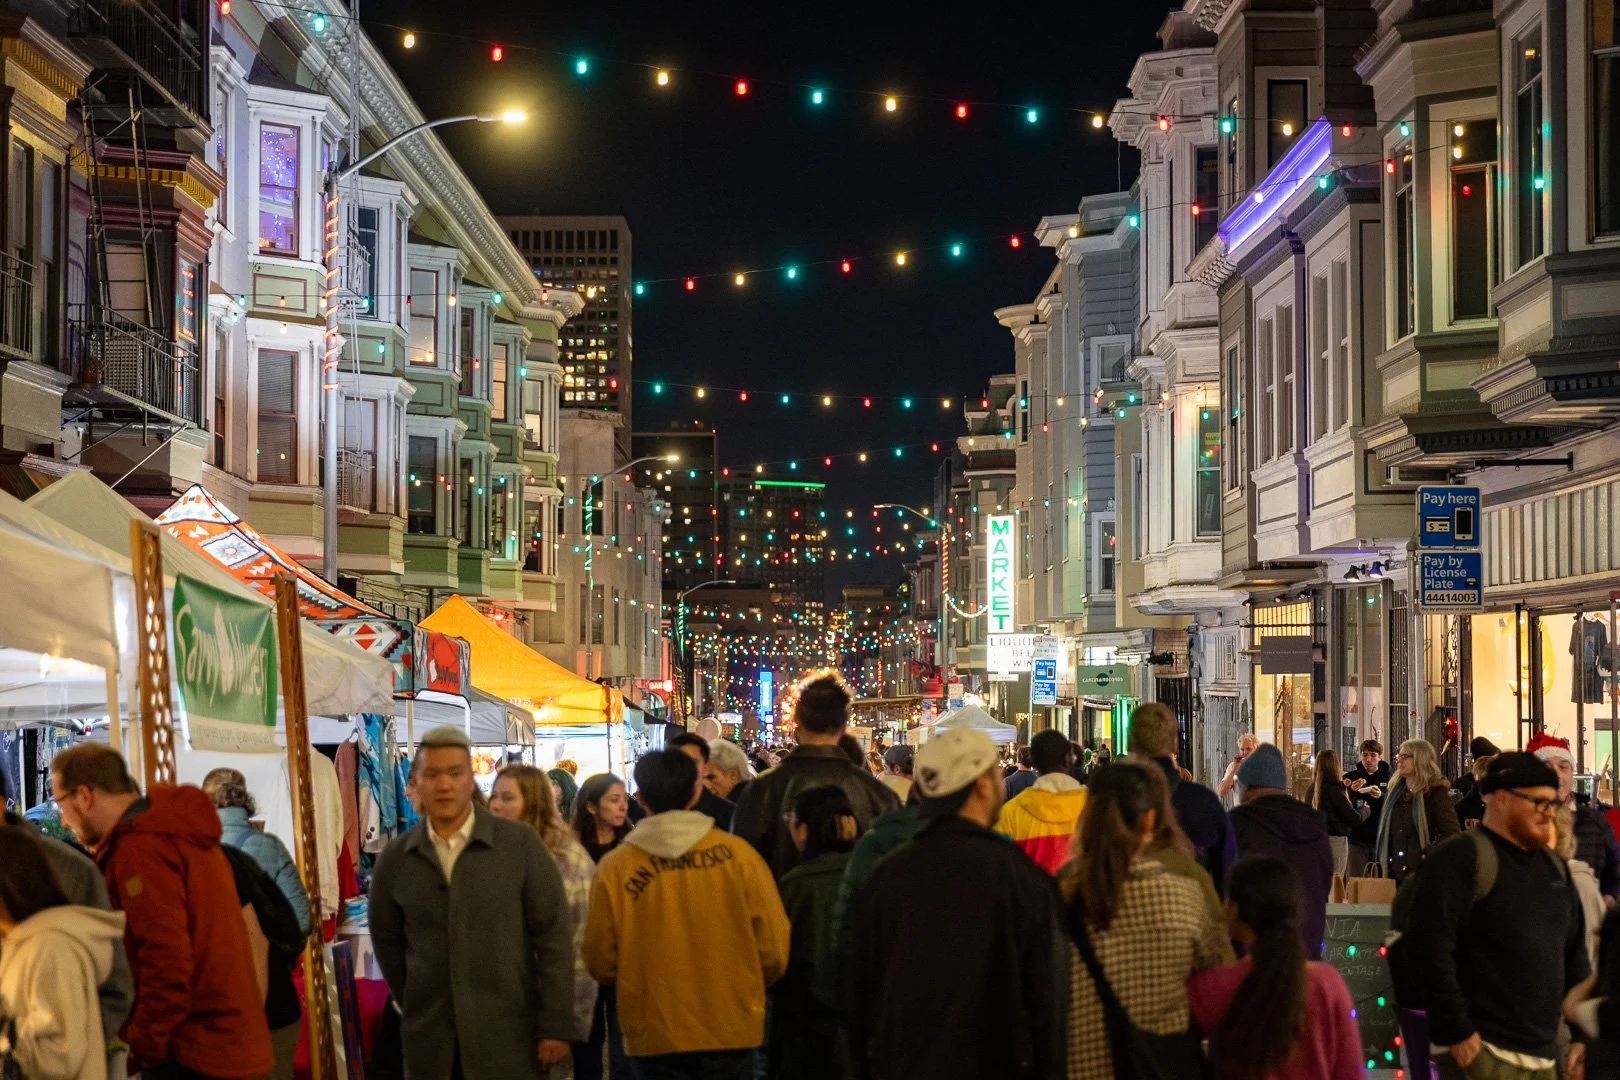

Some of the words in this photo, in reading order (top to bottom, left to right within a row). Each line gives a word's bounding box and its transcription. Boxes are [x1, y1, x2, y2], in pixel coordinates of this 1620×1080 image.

[1423, 492, 1446, 506] Pay
[1448, 492, 1477, 504] here
[1424, 556, 1445, 568] Pay
[1449, 555, 1463, 568] by
[991, 520, 1010, 630] MARKET
[1424, 567, 1467, 578] License
[1424, 578, 1454, 589] Plate
[1426, 593, 1477, 603] 44414003
[990, 637, 1035, 646] LIQUO
[1012, 649, 1031, 657] BEE
[649, 681, 663, 690] BAR
[624, 864, 656, 901] SAN
[649, 843, 733, 874] FRANCISCO
[1325, 918, 1361, 939] VIA
[1338, 965, 1382, 977] INTAGE
